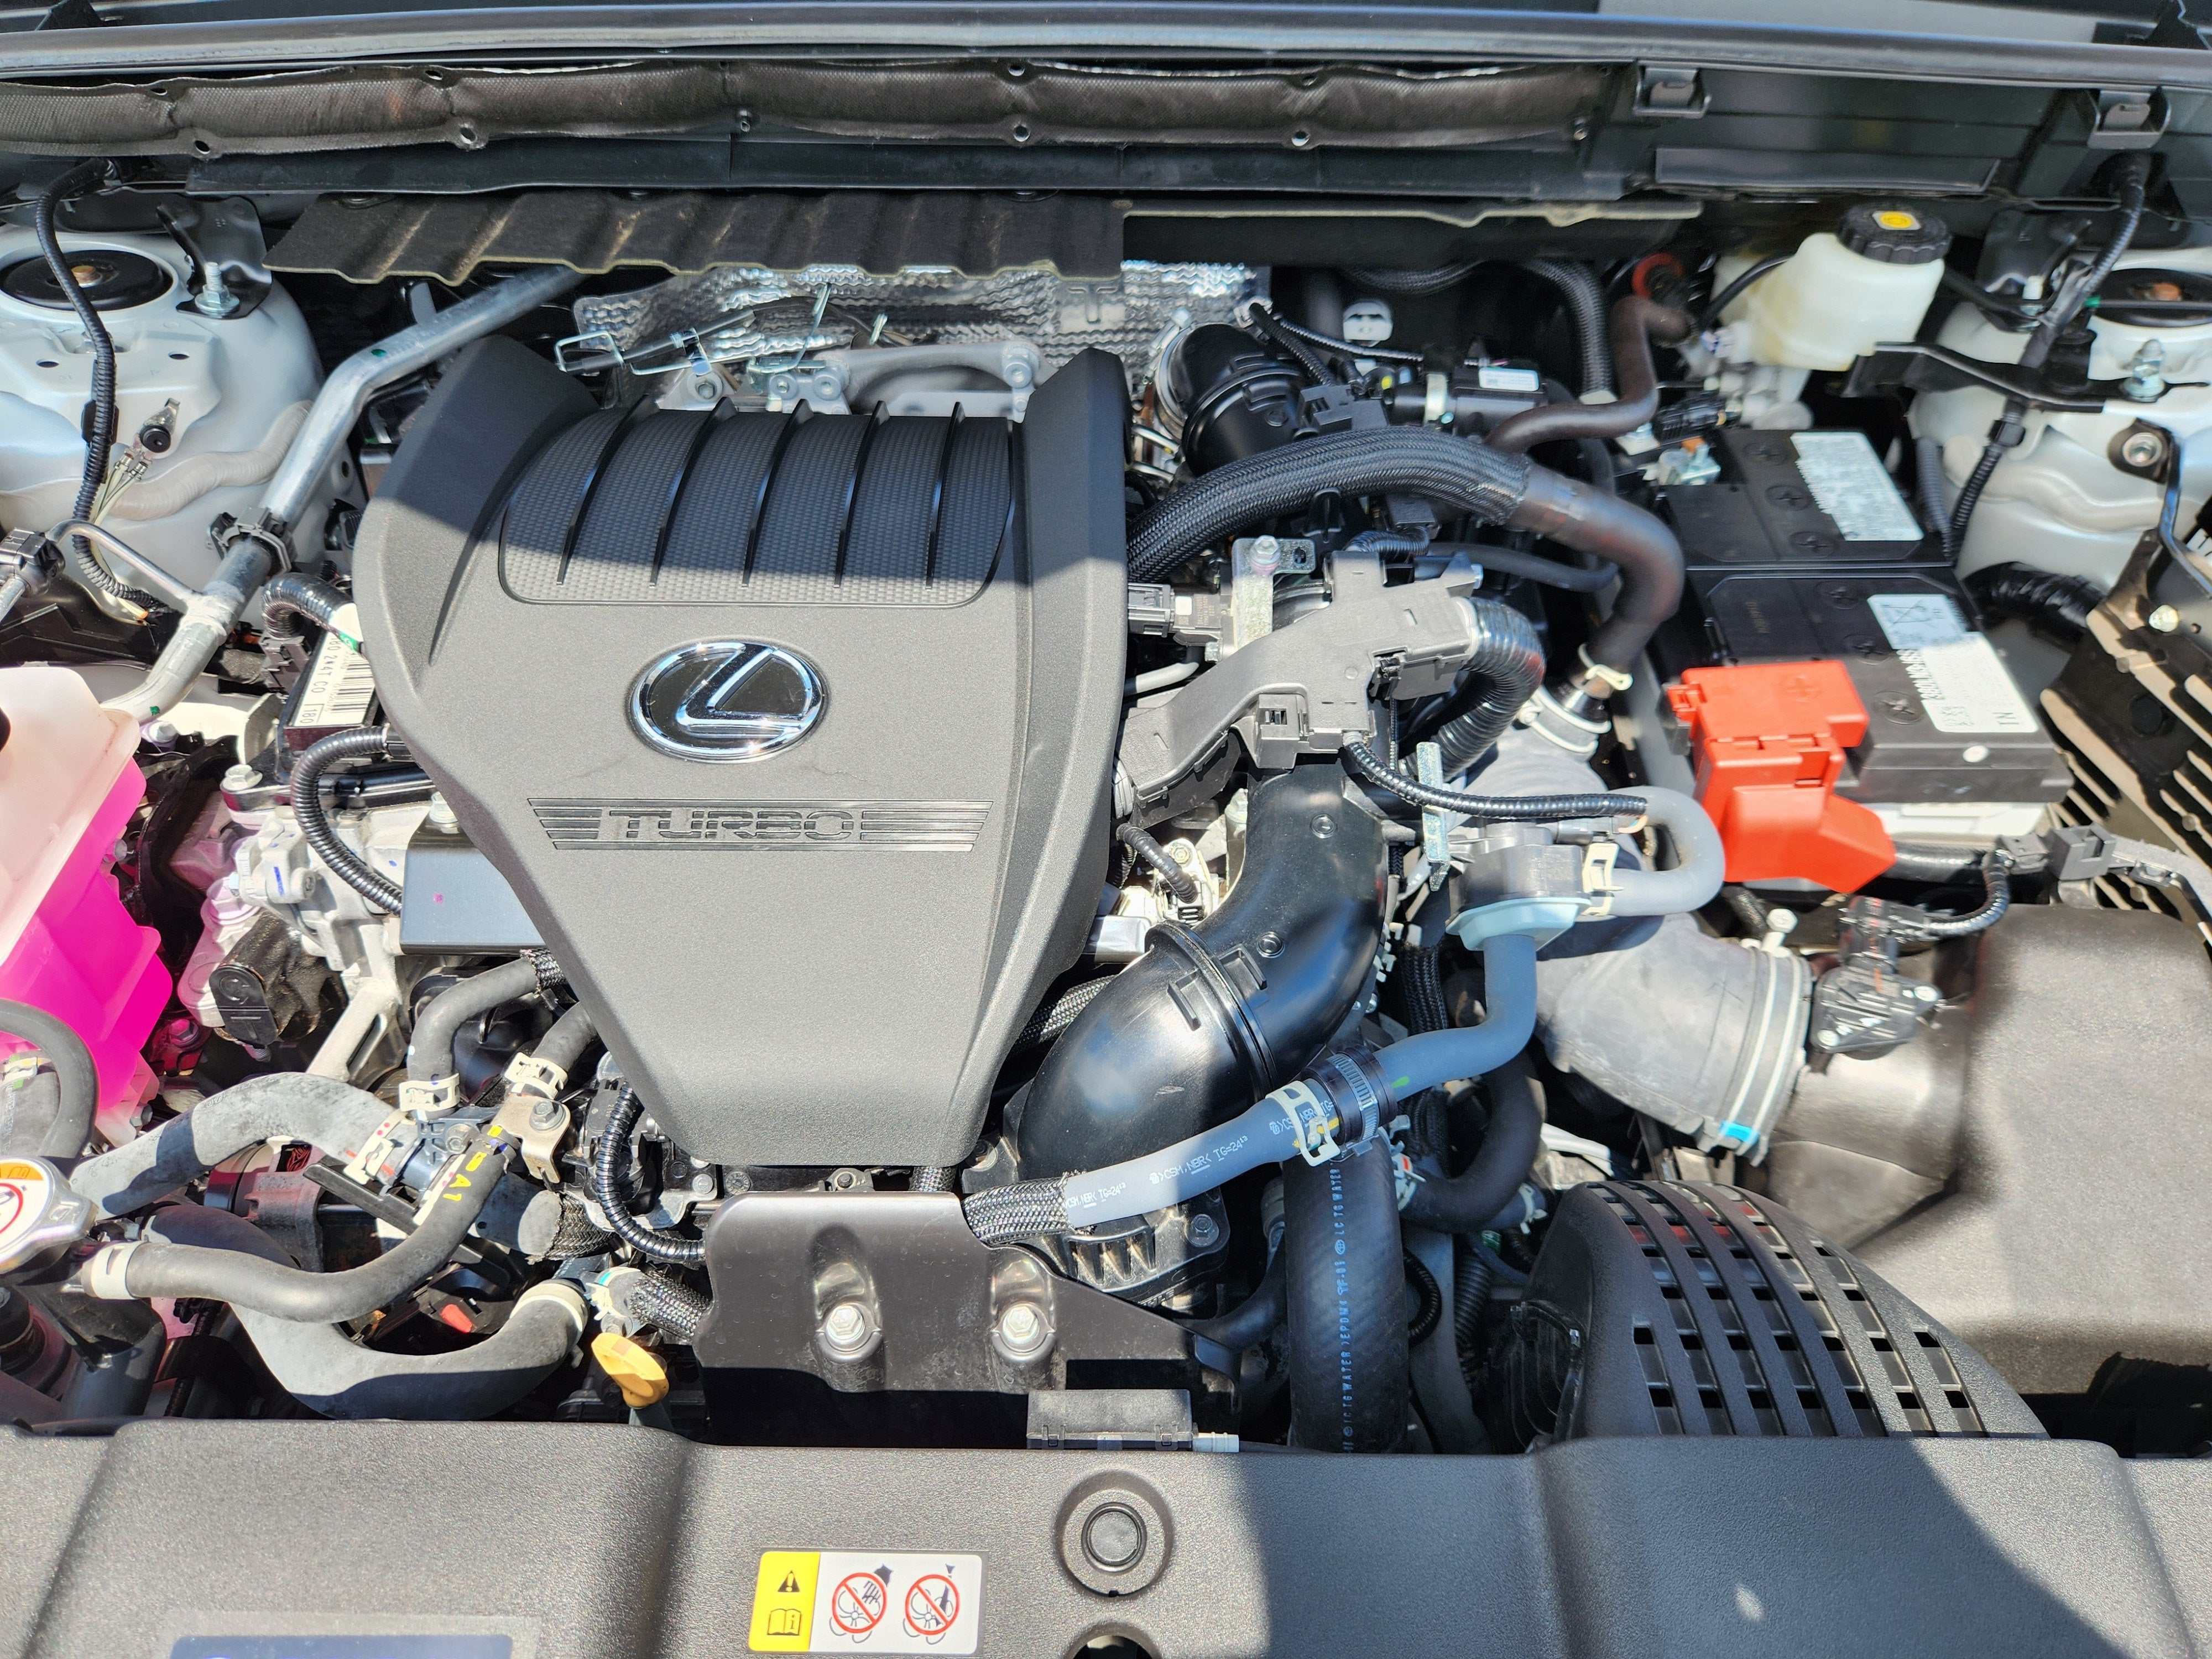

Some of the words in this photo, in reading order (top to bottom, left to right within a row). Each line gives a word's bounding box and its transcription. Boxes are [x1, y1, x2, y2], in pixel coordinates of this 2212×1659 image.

[300, 709, 317, 723] 180
[609, 810, 854, 839] TURBO
[1330, 1169, 1343, 1201] WATER
[1340, 1352, 1353, 1391] WATER
